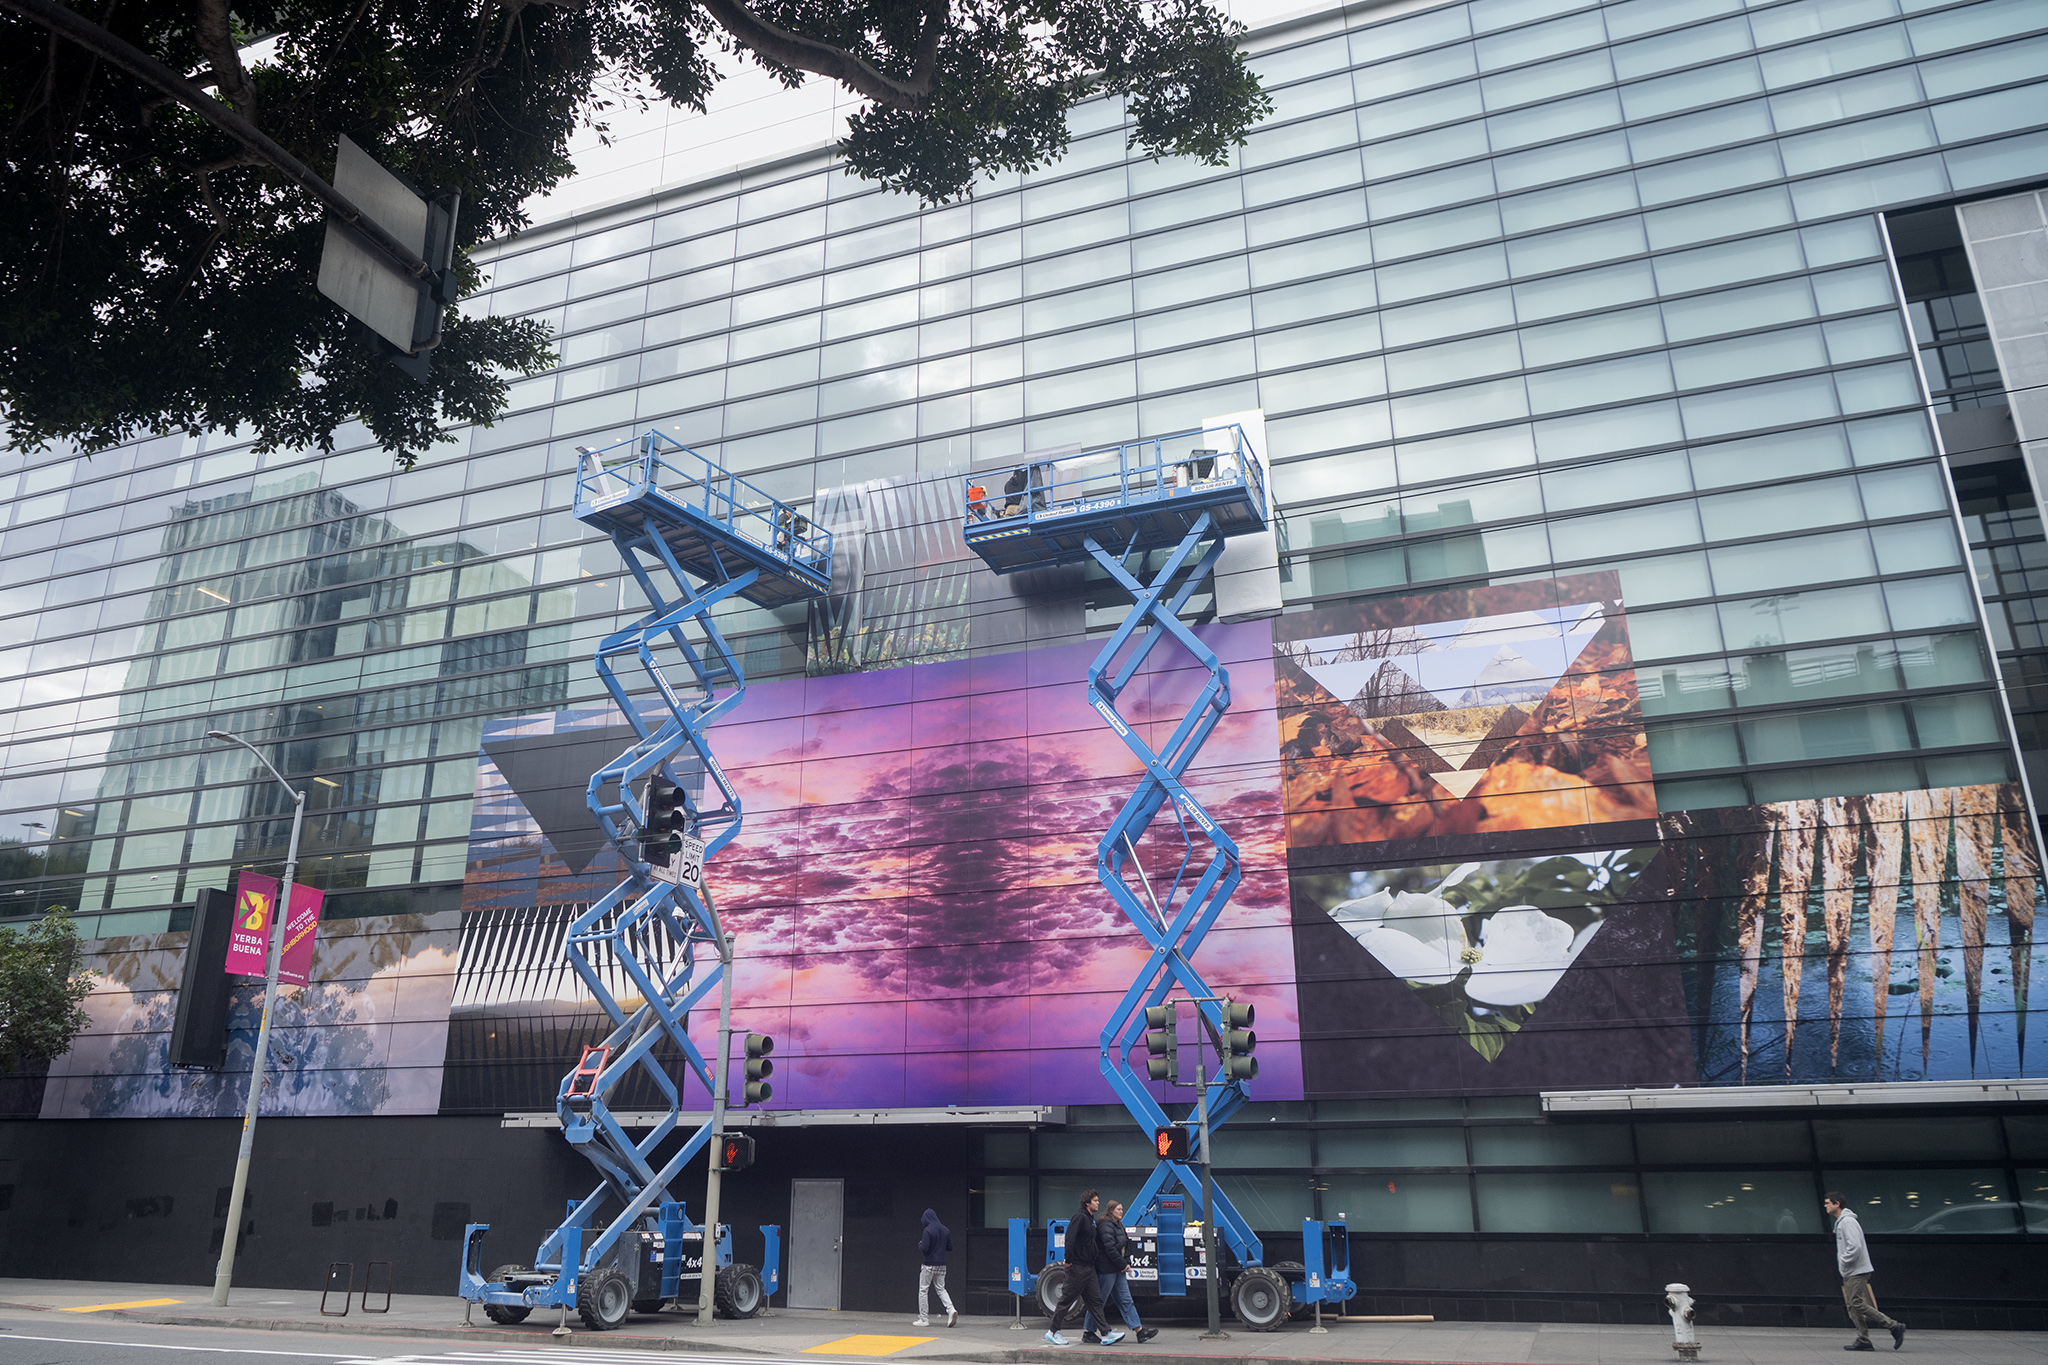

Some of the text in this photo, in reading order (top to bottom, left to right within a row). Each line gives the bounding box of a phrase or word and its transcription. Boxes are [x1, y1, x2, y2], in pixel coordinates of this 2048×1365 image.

[1079, 500, 1115, 512] GS-4390
[685, 840, 703, 854] SPEED
[686, 852, 700, 862] LIMIT
[682, 862, 699, 882] 20
[286, 907, 313, 931] WELCOME
[295, 913, 315, 932] TO THE
[234, 933, 262, 946] YERBA
[233, 944, 261, 955] BUENA
[686, 1257, 702, 1268] 4x4
